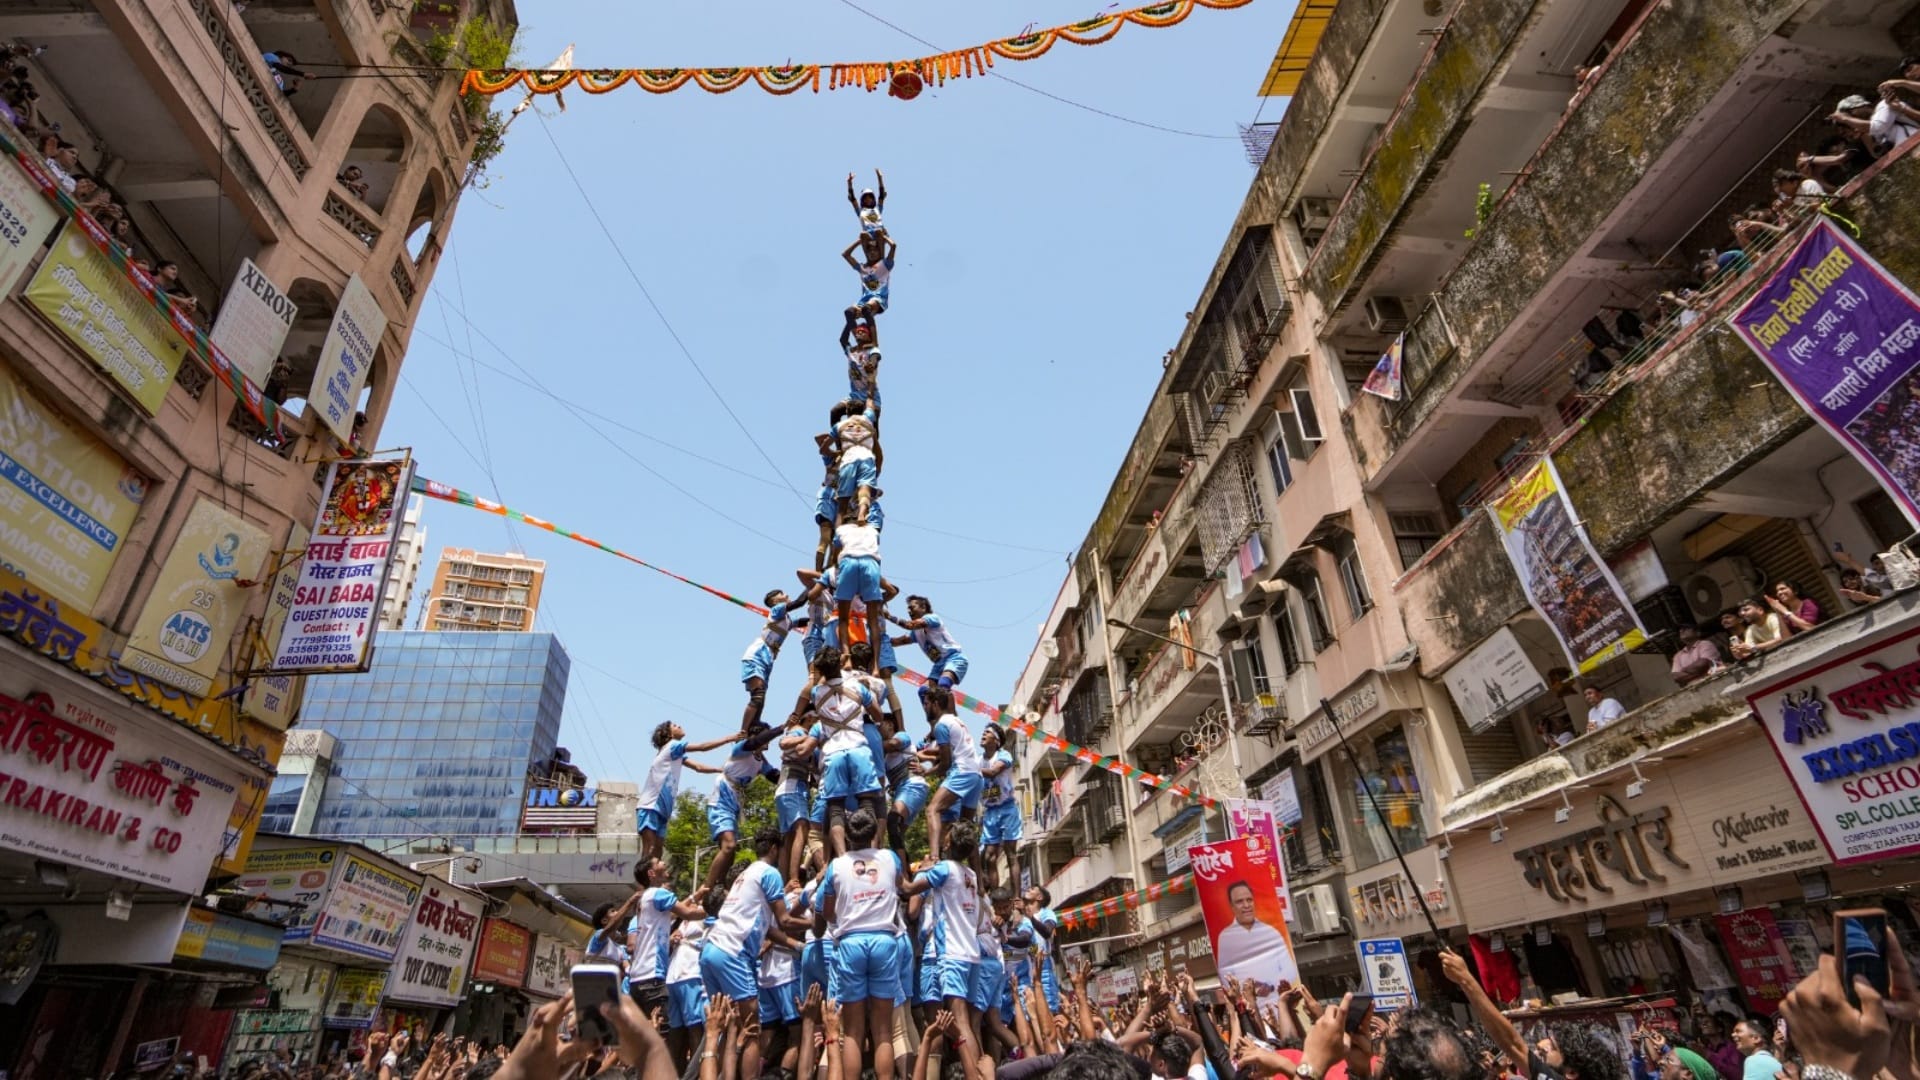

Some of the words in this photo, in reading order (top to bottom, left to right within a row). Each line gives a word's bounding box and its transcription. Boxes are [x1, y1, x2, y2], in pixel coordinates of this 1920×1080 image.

[1801, 245, 1854, 292] निवास
[241, 263, 296, 326] XEROX
[1833, 331, 1859, 357] आणि
[1821, 366, 1869, 411] व्यापारी
[16, 470, 116, 547] EXCELLENCE
[45, 518, 92, 560] ICSE
[307, 538, 349, 561] साई
[349, 540, 391, 560] बाबा
[309, 563, 336, 580] गेस्ट
[338, 563, 375, 580] हाऊस
[190, 590, 215, 610] 25
[293, 585, 325, 606] SAI
[328, 583, 375, 604] BABA
[166, 613, 211, 645] ARTS
[292, 608, 328, 622] GUEST
[330, 607, 368, 619] HOUSE
[303, 623, 342, 634] Contact
[161, 631, 175, 649] XI
[278, 654, 321, 666] GROUND
[321, 653, 357, 665] FLOOR.
[113, 758, 172, 806] आणि
[528, 788, 597, 808] INOX
[125, 817, 142, 842] &
[154, 827, 182, 854] CO
[1712, 804, 1790, 848] Mahavir
[1843, 824, 1898, 844] COMPOSITION
[1191, 846, 1234, 881] साहेब
[1512, 793, 1691, 904] महावीर
[1716, 853, 1748, 872] Men's
[1749, 843, 1786, 864] Ethnic
[1786, 837, 1819, 857] Wear
[415, 887, 446, 932] टॉय
[402, 956, 423, 983] TOY
